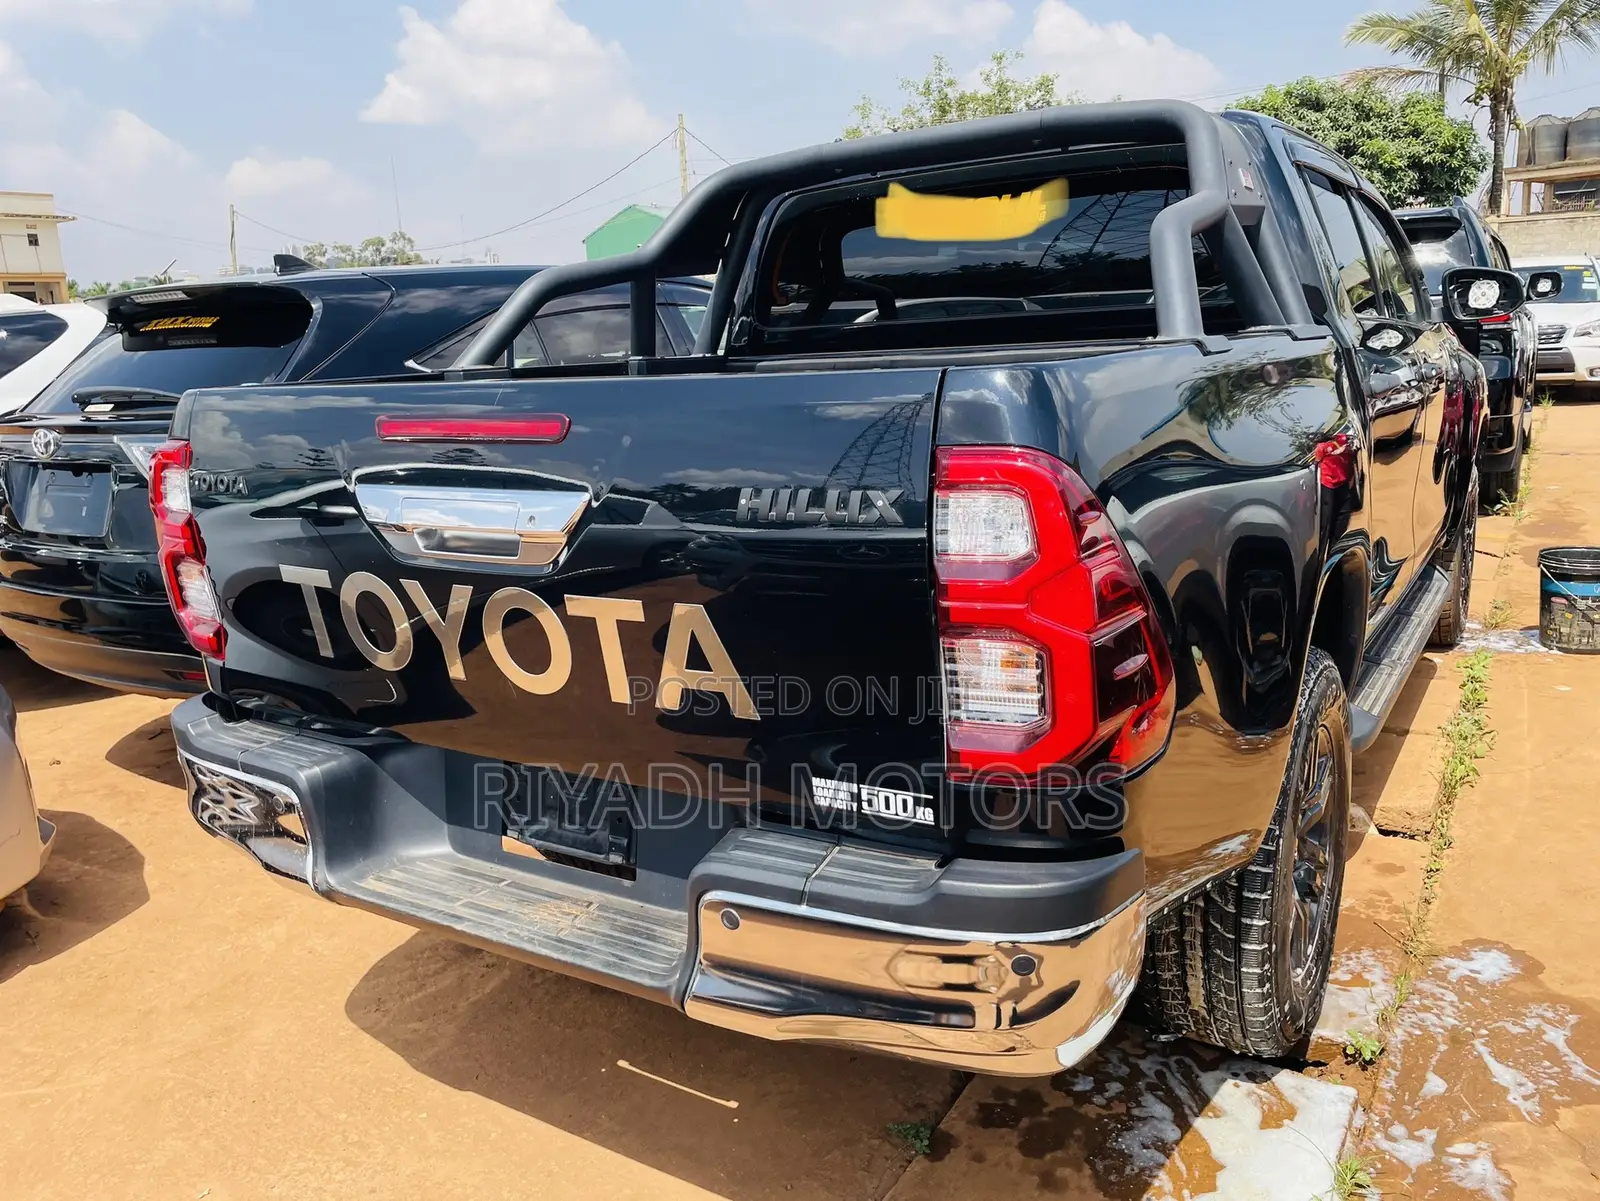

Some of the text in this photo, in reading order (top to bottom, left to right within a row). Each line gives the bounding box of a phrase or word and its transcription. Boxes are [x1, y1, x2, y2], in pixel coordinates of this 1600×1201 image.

[193, 474, 249, 496] TOYOTA
[736, 487, 904, 525] HILUX
[279, 564, 761, 720] TOYOTA
[812, 777, 858, 793] MAXIMUM
[814, 796, 858, 812] CAPACITY
